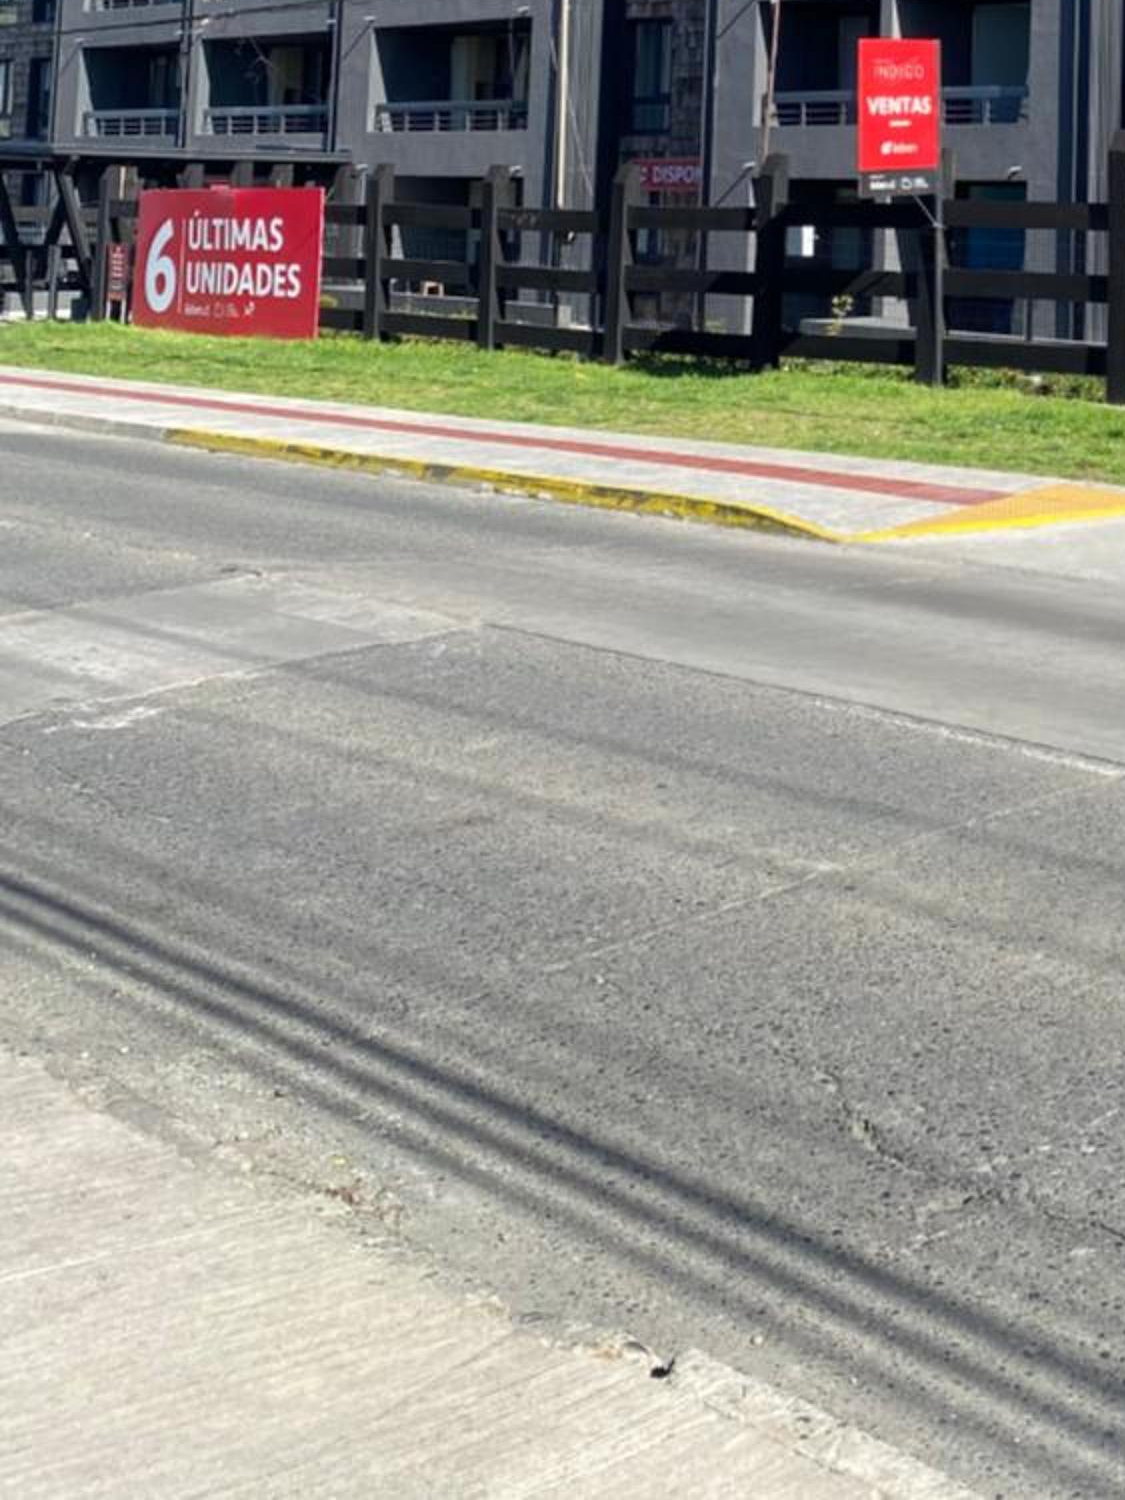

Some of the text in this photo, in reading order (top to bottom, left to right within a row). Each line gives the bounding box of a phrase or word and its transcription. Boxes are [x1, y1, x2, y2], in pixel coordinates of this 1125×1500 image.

[867, 96, 931, 115] VENTAS
[188, 210, 284, 251] ÚLTIMAS
[145, 219, 176, 312] 6
[186, 263, 301, 298] UNIDADES
